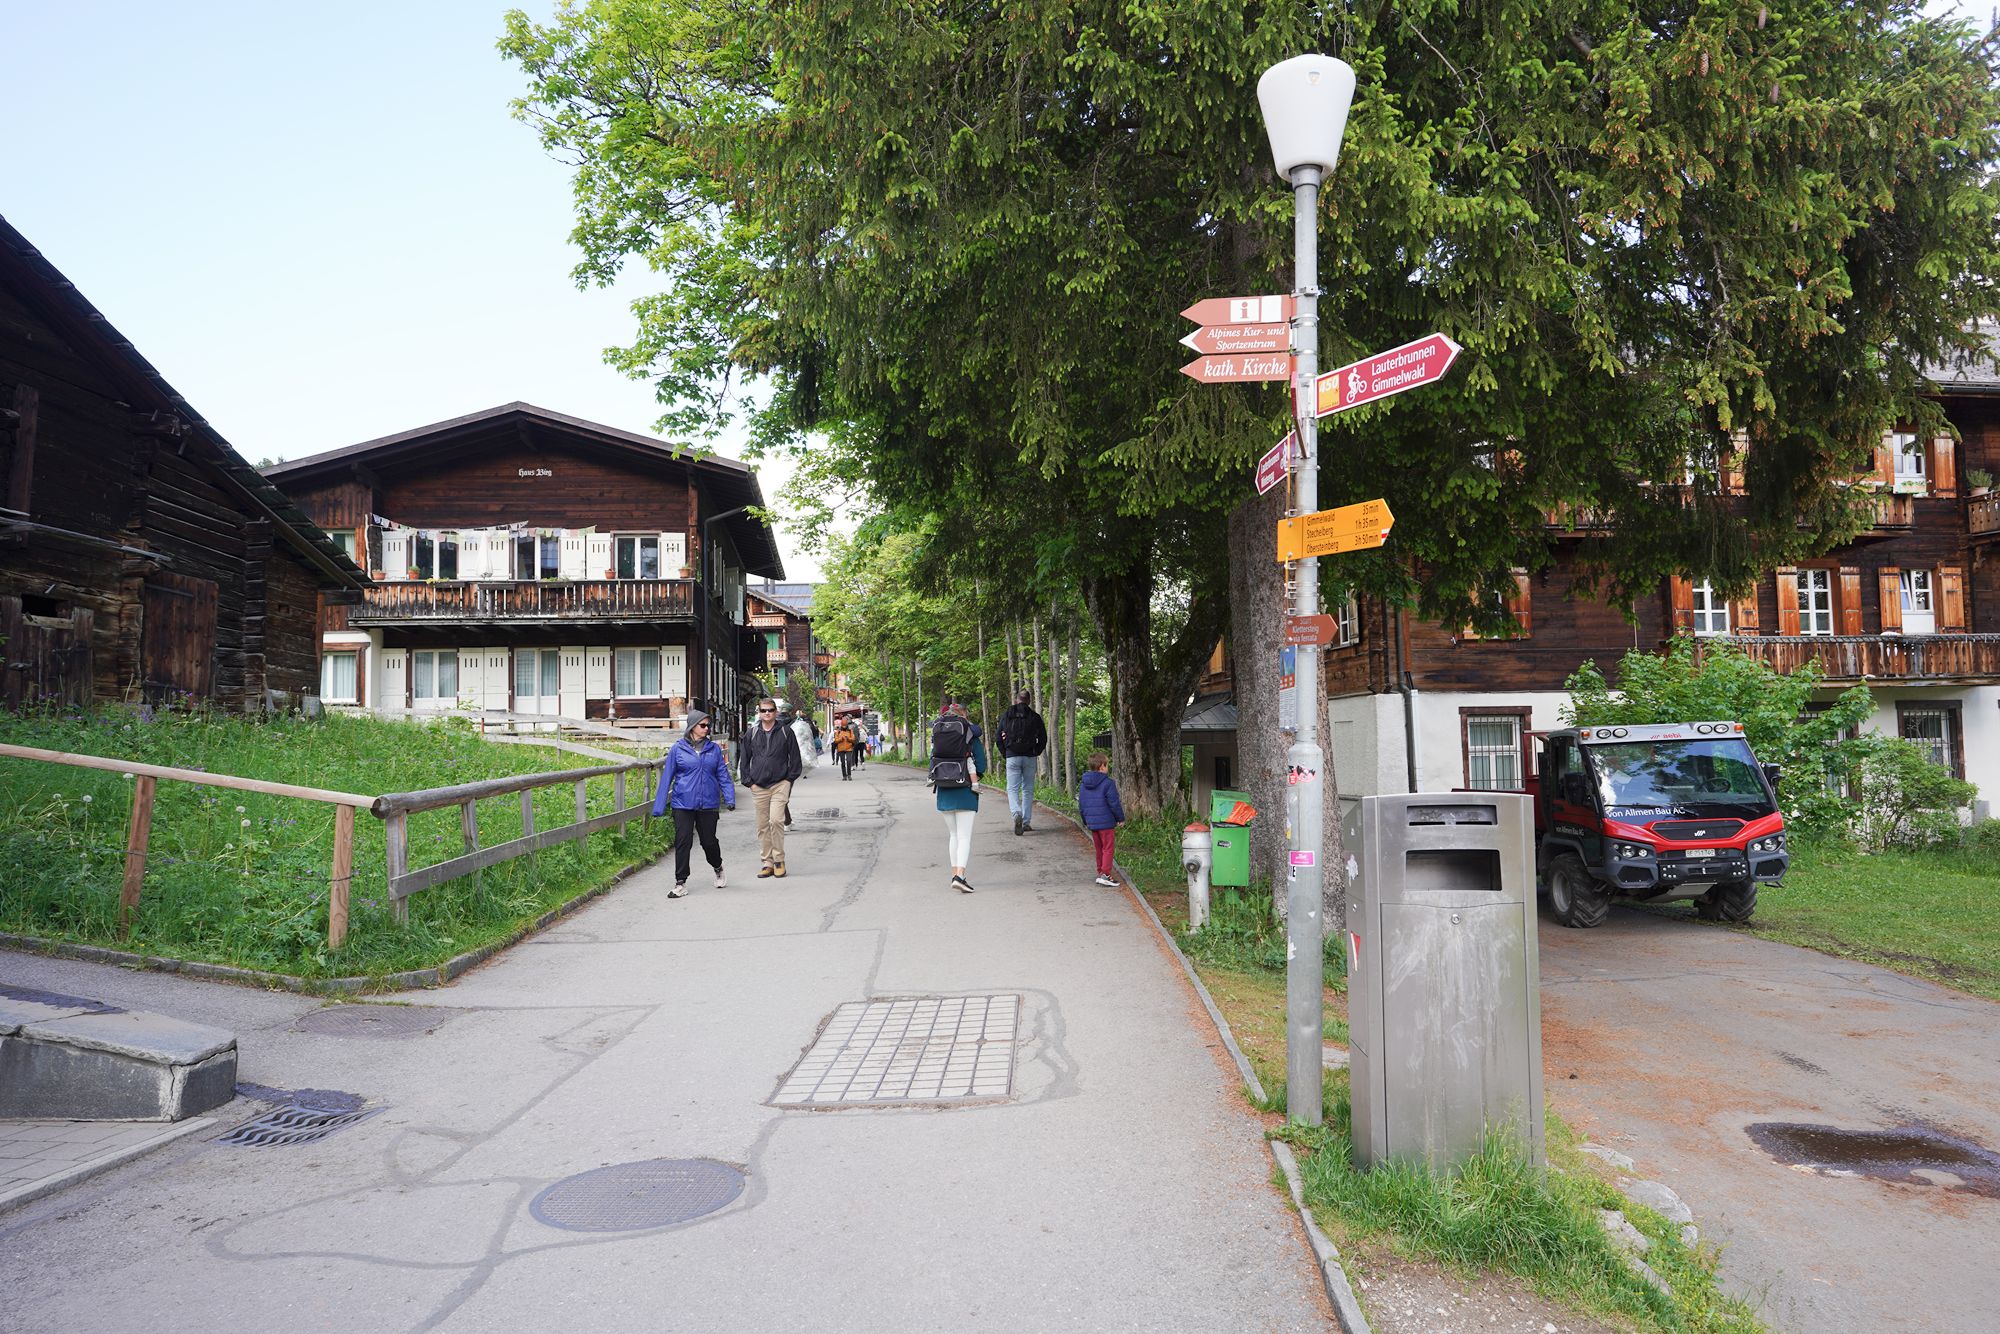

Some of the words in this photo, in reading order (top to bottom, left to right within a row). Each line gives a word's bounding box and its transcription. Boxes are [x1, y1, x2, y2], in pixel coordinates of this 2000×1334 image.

[1207, 327, 1241, 339] Alpines
[1243, 327, 1264, 336] Kur-
[1267, 325, 1286, 336] und
[1216, 339, 1276, 352] Sportzentrum
[1204, 359, 1237, 377] kath.
[1241, 357, 1287, 376] Kirche
[1371, 344, 1436, 376] Lauterbrunnen
[1371, 363, 1425, 393] Gimmelwald
[518, 468, 535, 477] Haus
[1624, 808, 1655, 816] Allmen
[1655, 807, 1672, 815] Bau
